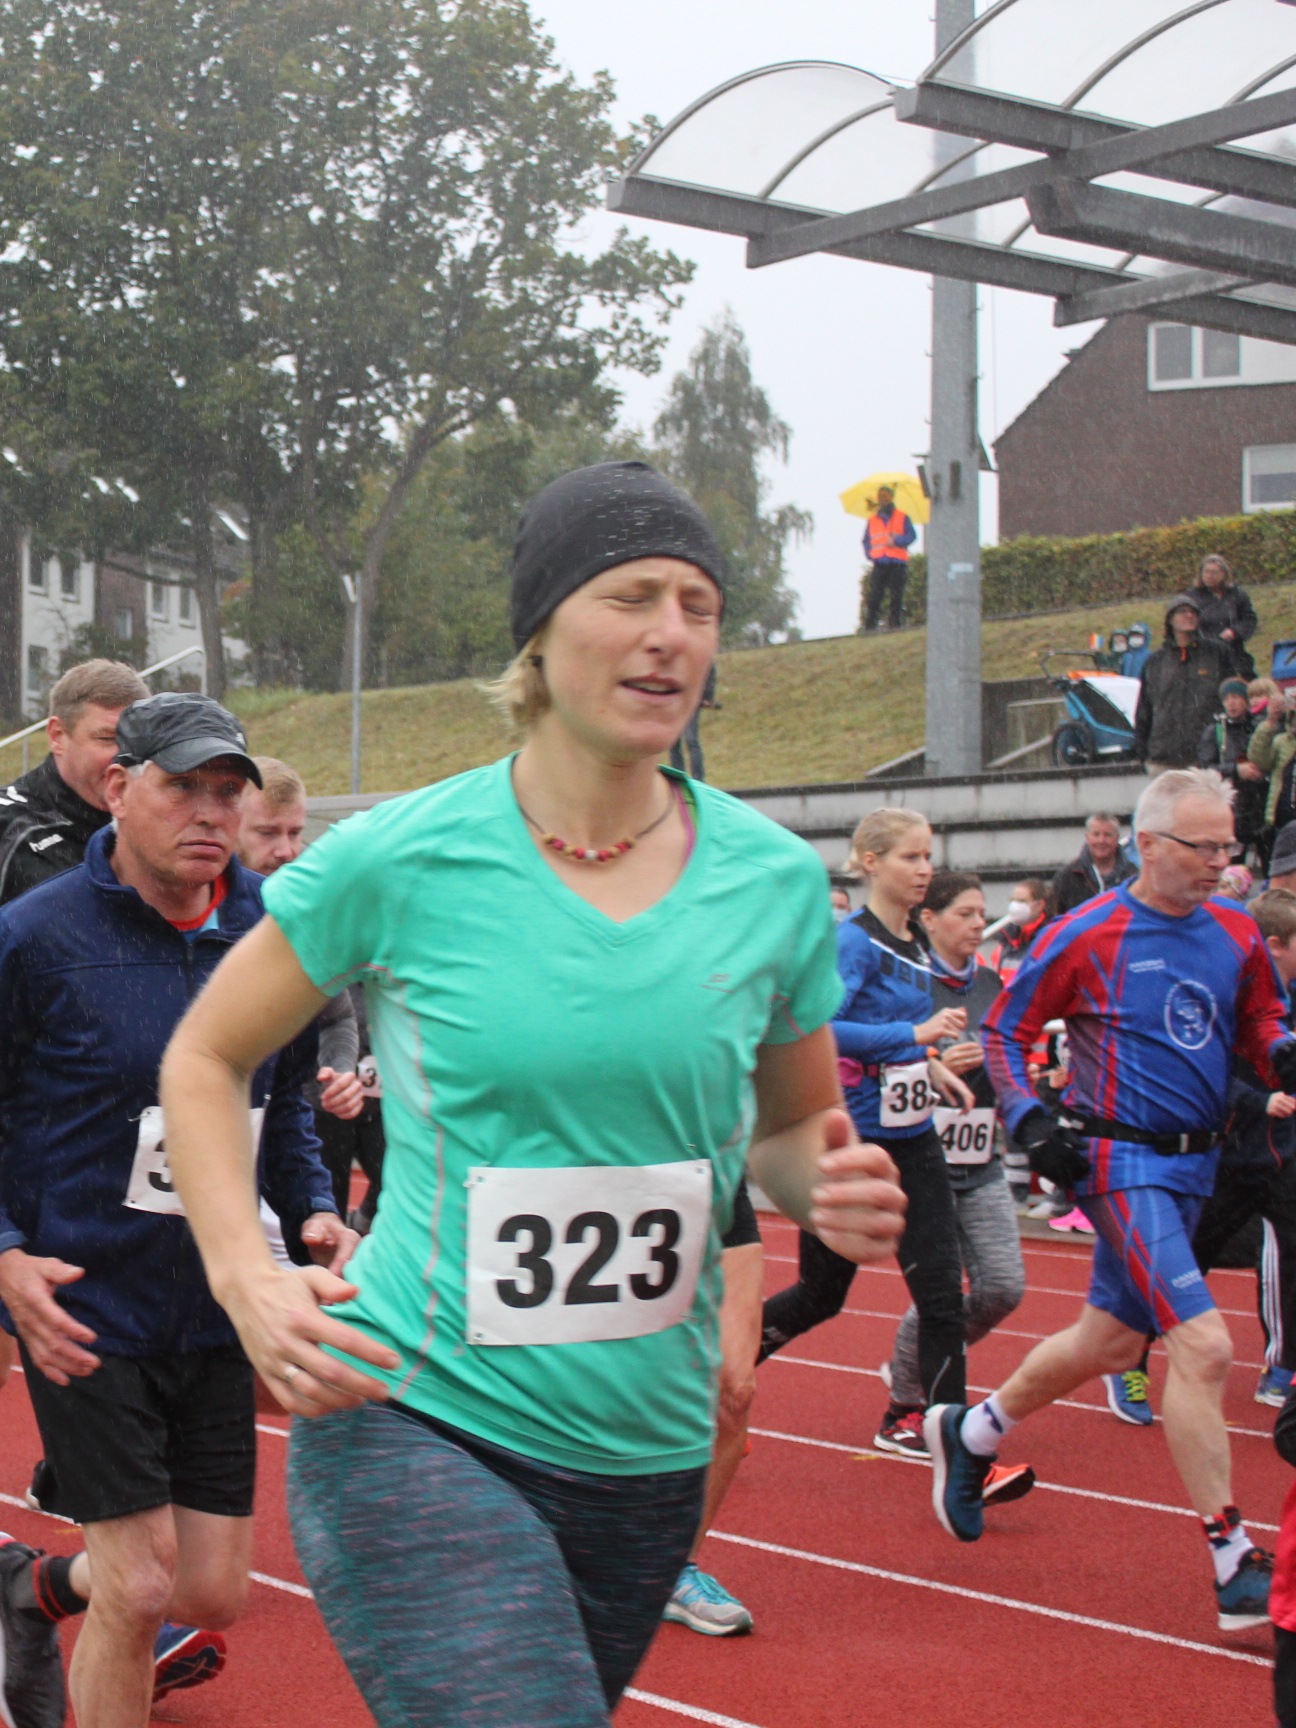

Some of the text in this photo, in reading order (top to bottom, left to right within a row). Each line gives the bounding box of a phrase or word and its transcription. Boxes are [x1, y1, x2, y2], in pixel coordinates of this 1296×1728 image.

[889, 1079, 939, 1113] 38
[941, 1122, 989, 1152] 406
[495, 1207, 683, 1309] 323
